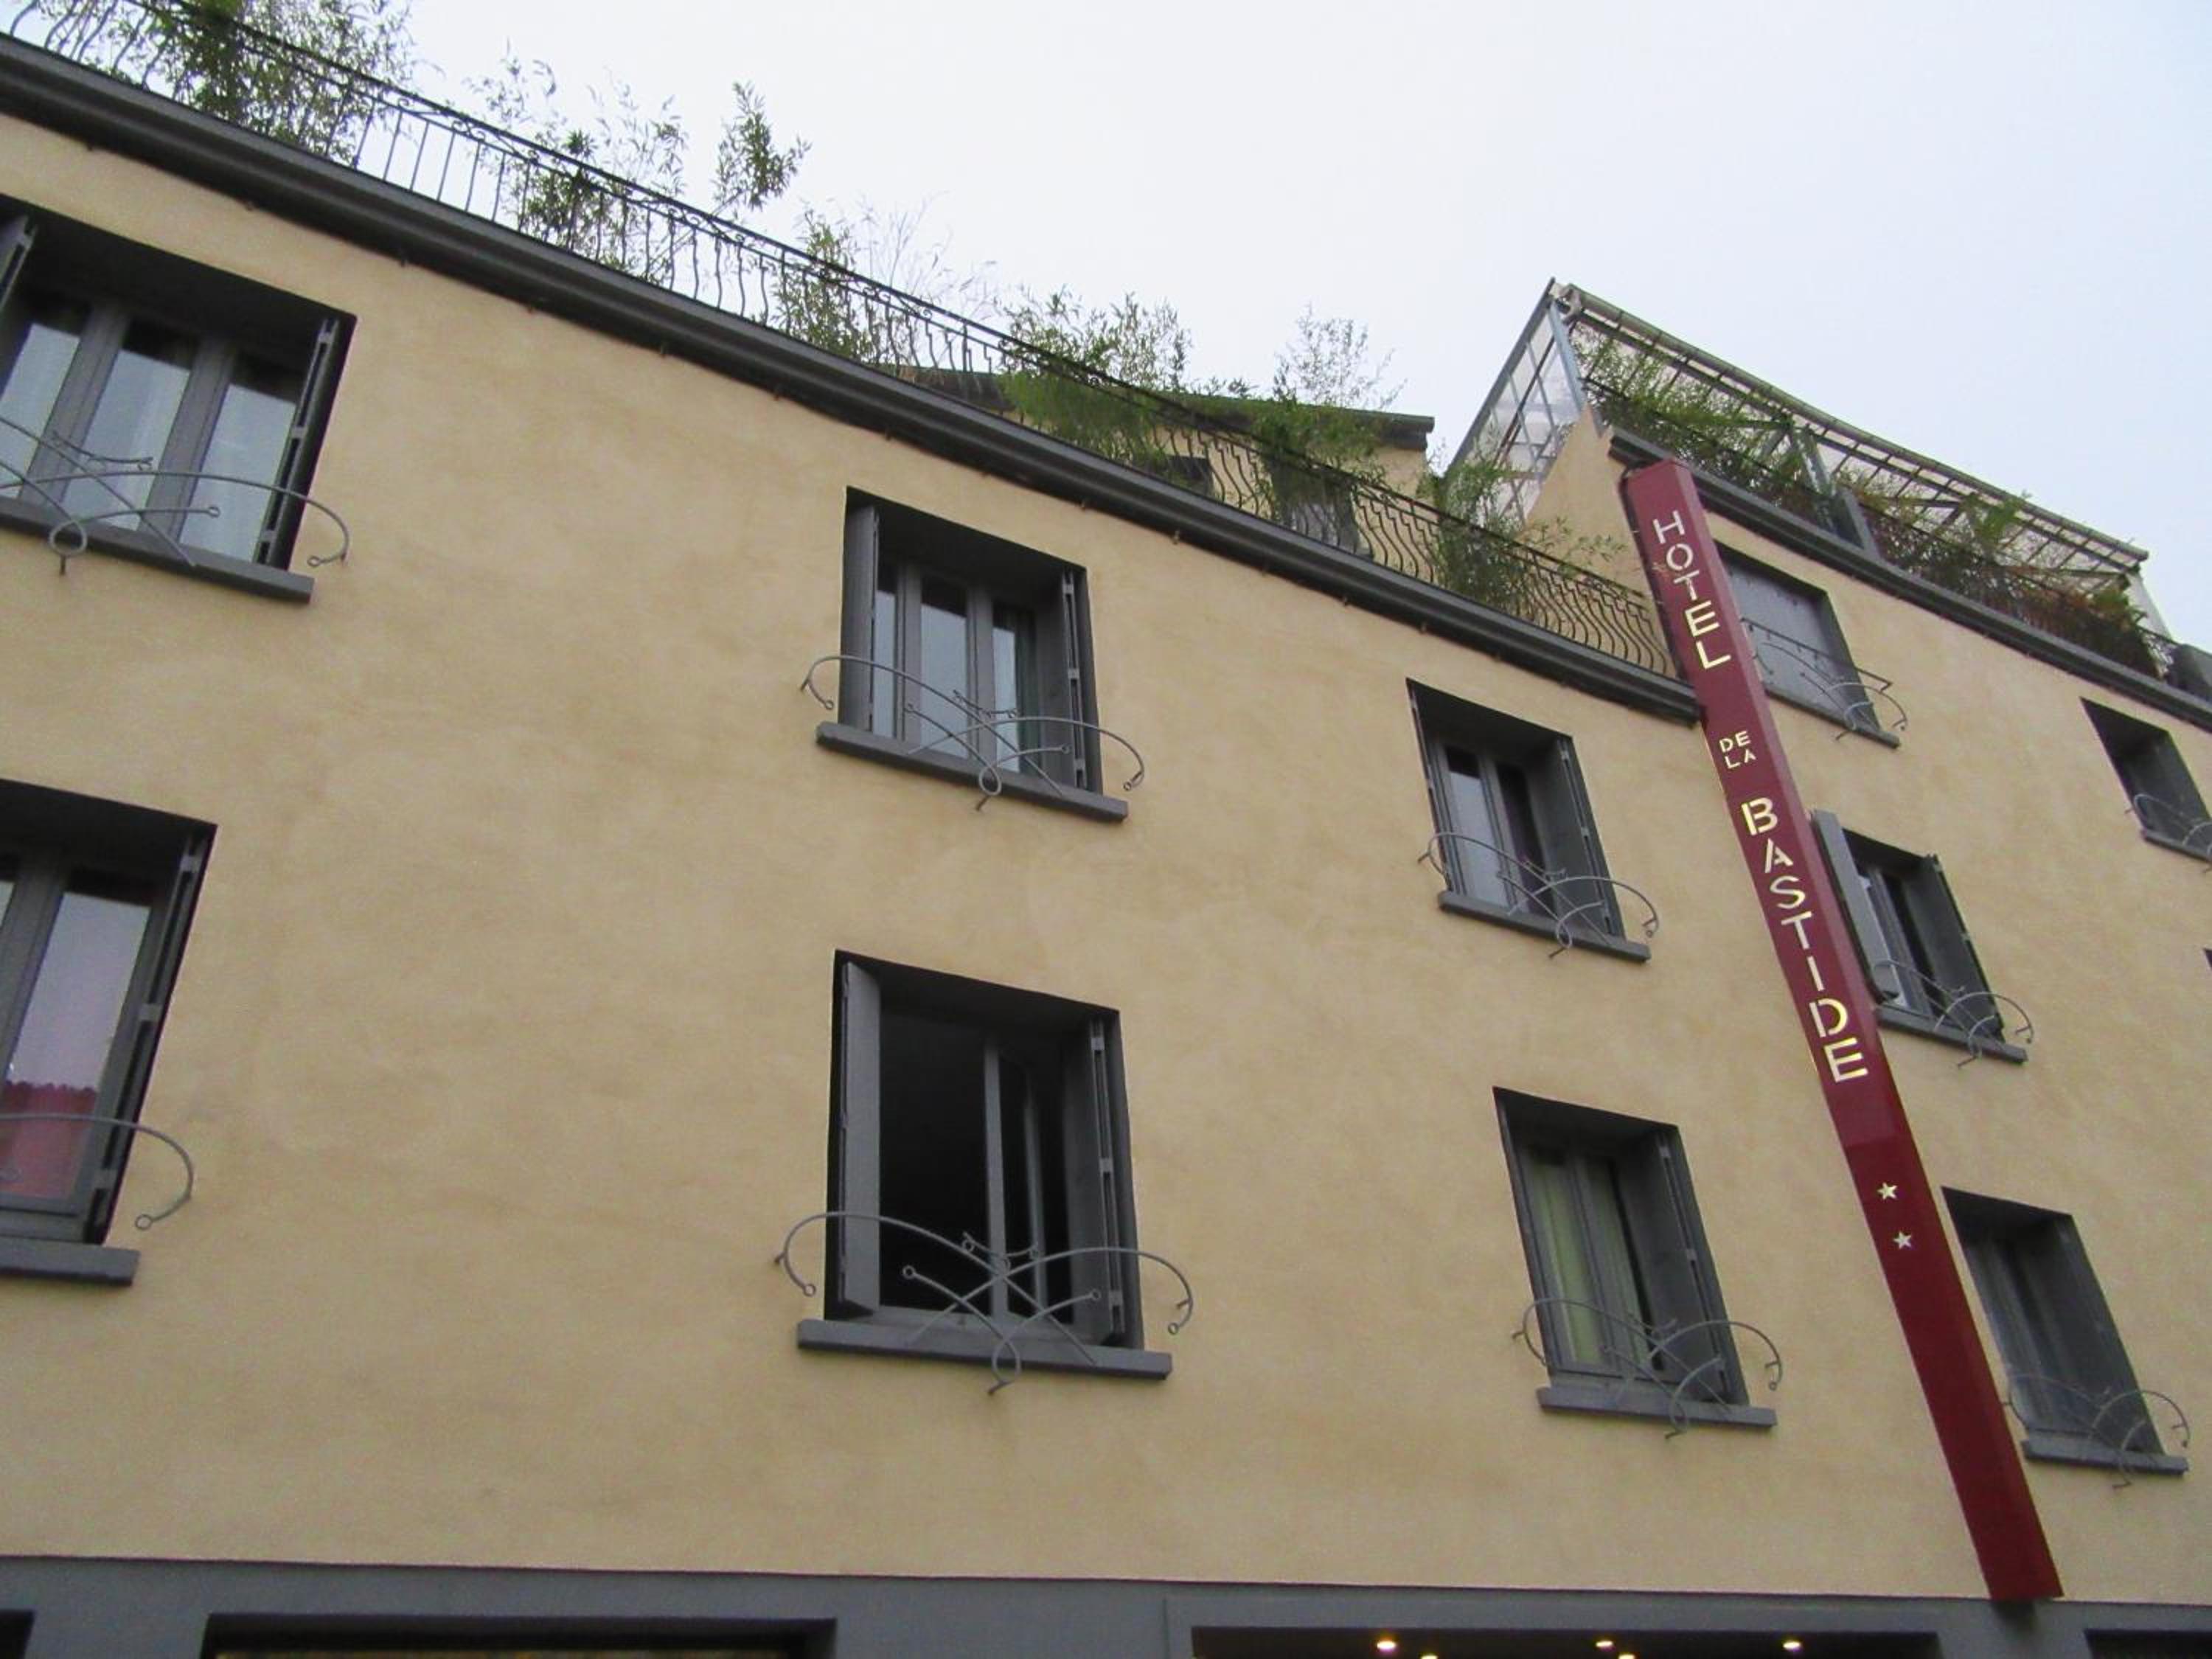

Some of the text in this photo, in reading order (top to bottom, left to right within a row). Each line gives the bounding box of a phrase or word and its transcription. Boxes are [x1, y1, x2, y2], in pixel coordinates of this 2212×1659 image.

[1652, 509, 1731, 669] HOTEL
[1719, 731, 1751, 753] DE
[1724, 748, 1756, 769] LA
[1741, 797, 1868, 1082] BASTIDE
